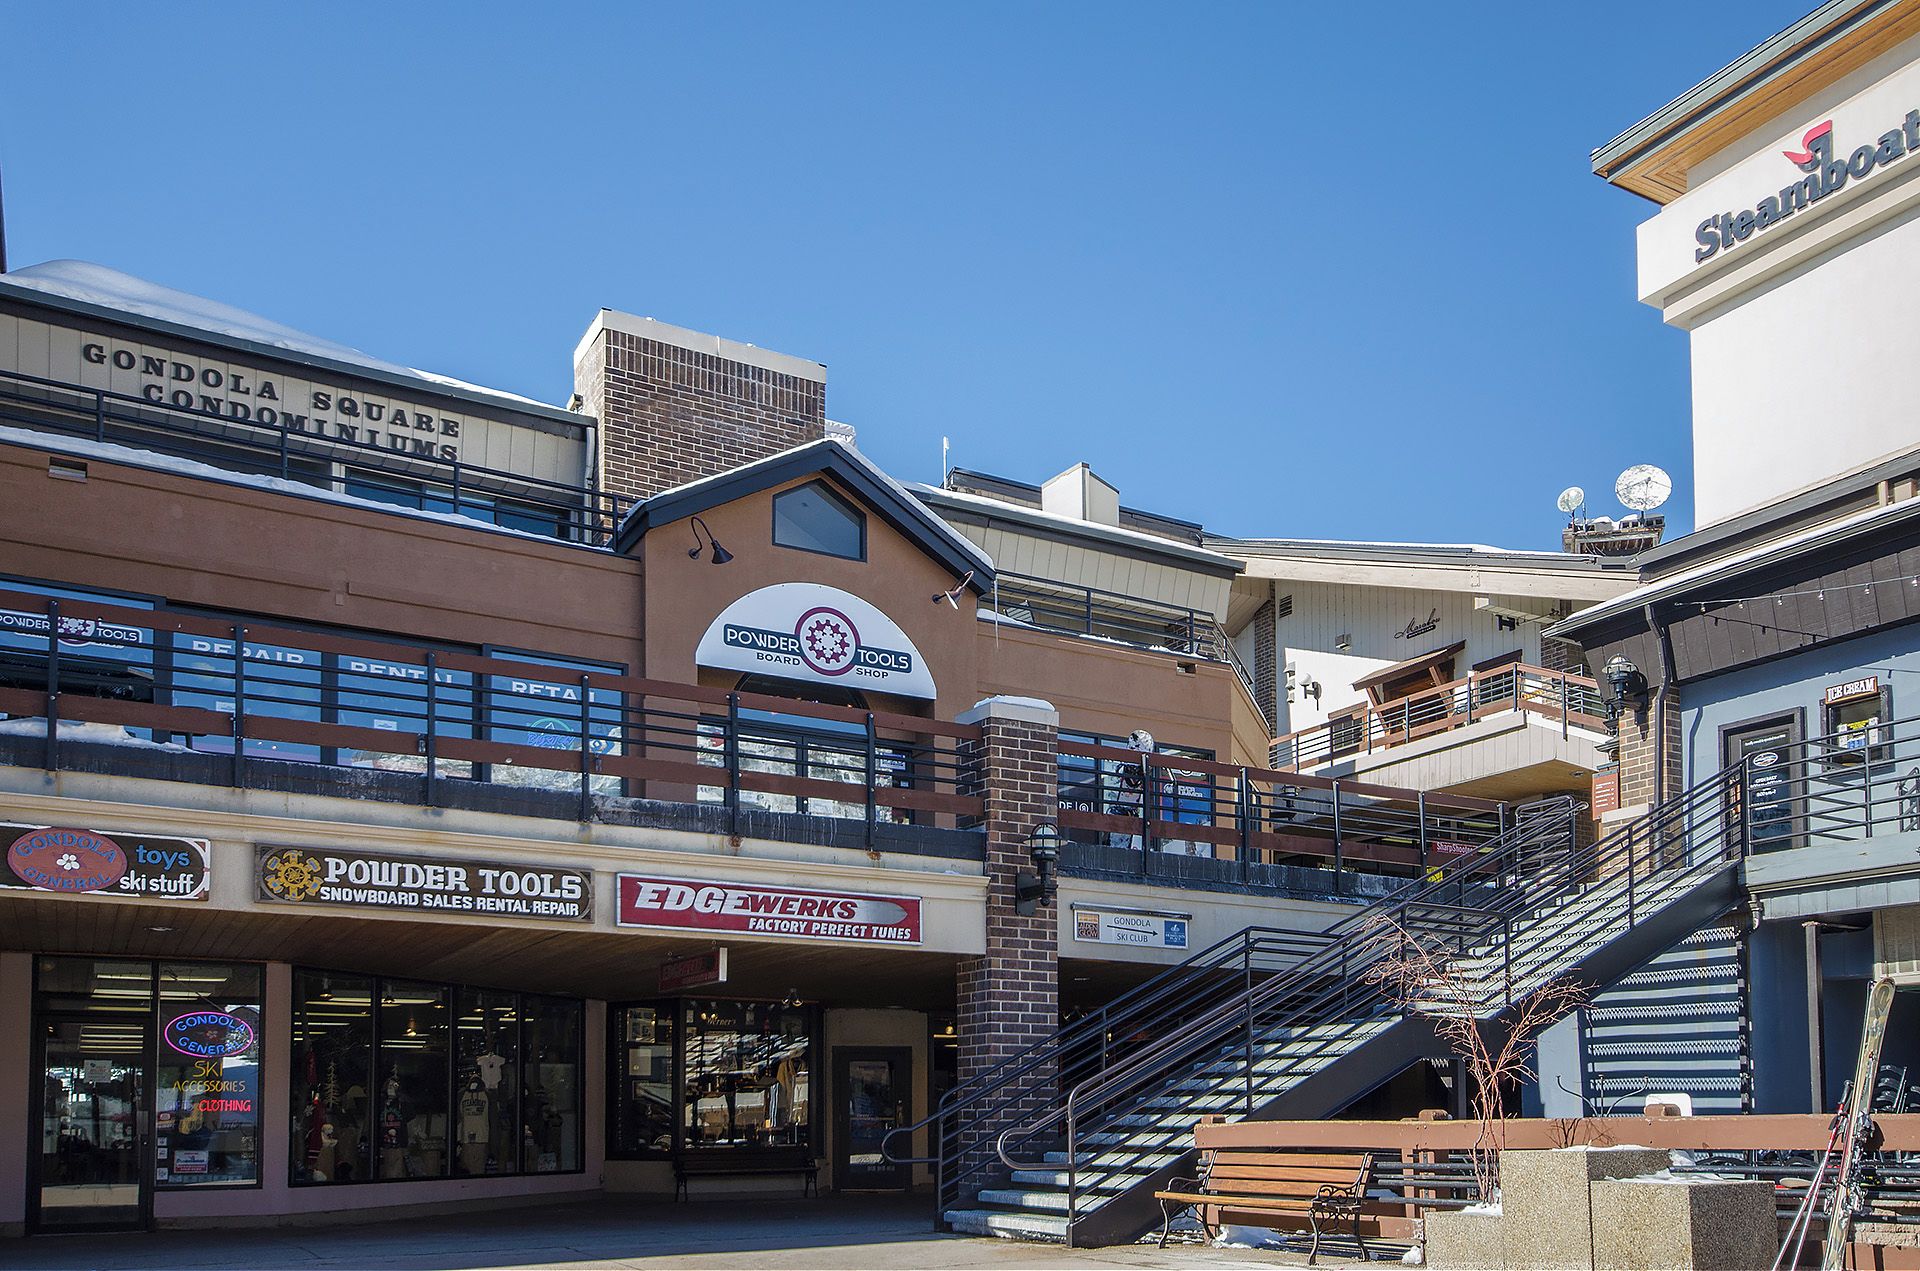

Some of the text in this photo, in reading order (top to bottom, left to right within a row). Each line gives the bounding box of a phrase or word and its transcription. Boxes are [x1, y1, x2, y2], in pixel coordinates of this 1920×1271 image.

[1695, 108, 1920, 265] Steamboat
[83, 343, 460, 438] GONDOLA SQUARE
[143, 384, 458, 463] CONDOMINIUMS
[96, 627, 138, 642] TOOLS
[727, 628, 910, 670] POWDER TOOLS
[756, 652, 889, 679] BOARD SHOP
[1827, 677, 1876, 702] ICE CREAM
[15, 832, 117, 863] GONDOLA
[136, 844, 191, 871] toys
[24, 866, 111, 890] GENERAL
[119, 869, 195, 894] ski stuff
[324, 857, 582, 899] POWDER TOOLS
[320, 886, 419, 906] SNOWBOARD
[423, 893, 473, 910] SALES
[533, 900, 579, 916] REPAIR
[635, 881, 858, 920] EDGEWERKS
[748, 918, 912, 940] FACTORY PERFECT TUNES
[1113, 916, 1151, 928] GONDOLA
[1116, 933, 1149, 943] SKI CLUB
[175, 1014, 247, 1034] GONDOLA
[178, 1036, 245, 1055] GENERAL
[192, 1060, 224, 1078] SKI
[173, 1080, 246, 1093] ACCESSORIES
[198, 1099, 251, 1112] CLOTHING
